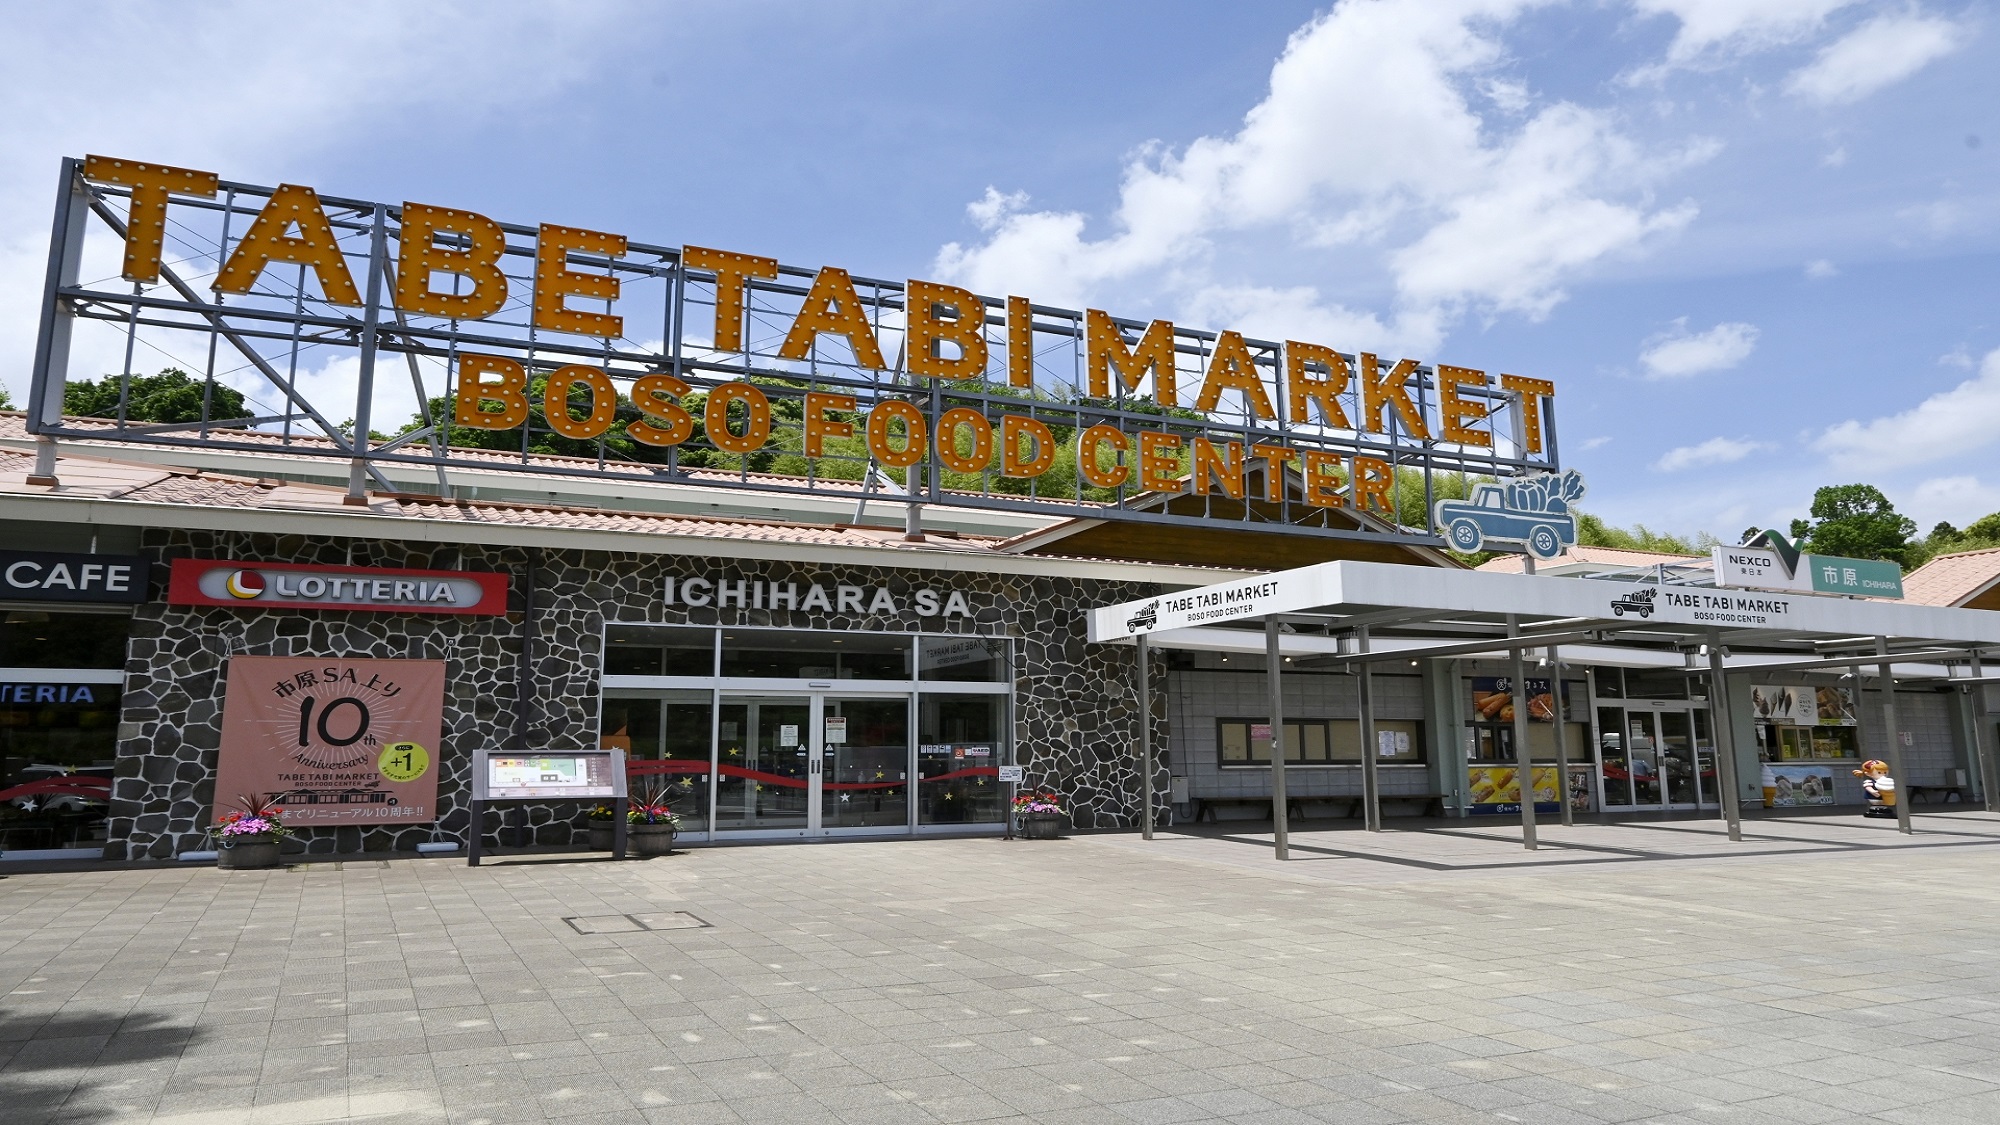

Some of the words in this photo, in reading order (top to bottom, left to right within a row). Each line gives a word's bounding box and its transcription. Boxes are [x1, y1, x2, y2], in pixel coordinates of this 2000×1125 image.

[1082, 307, 1556, 454] MARKET
[455, 352, 772, 453] BOSO
[802, 391, 1055, 479] FOOD
[1076, 424, 1395, 514] CENTER
[1729, 554, 1771, 567] NEXCO
[1741, 567, 1762, 576] 東日本
[5, 560, 132, 592] CAFE
[1822, 565, 1858, 586] 市原
[1861, 579, 1898, 590] ICHIHARA
[275, 575, 457, 604] LOTTERIA
[663, 575, 899, 616] ICHIHARA
[914, 588, 972, 618] SA
[1165, 599, 1193, 614] TABE
[1197, 591, 1223, 608] TABI
[1226, 581, 1279, 604] MARKET
[1187, 611, 1205, 622] BOSO
[1206, 608, 1224, 619] FOOD
[1225, 604, 1253, 617] CENTER
[1665, 592, 1700, 608] TABE
[1703, 595, 1734, 610] TABI
[1737, 598, 1790, 614] MARKET
[1694, 611, 1715, 621] BOSO
[1716, 613, 1736, 622] FOOD
[1736, 614, 1767, 624] CENTER
[291, 752, 370, 771] Anniversary
[390, 752, 412, 772] +1
[278, 773, 305, 781] TABE
[308, 773, 333, 781] TABI
[335, 772, 379, 781] MARKET
